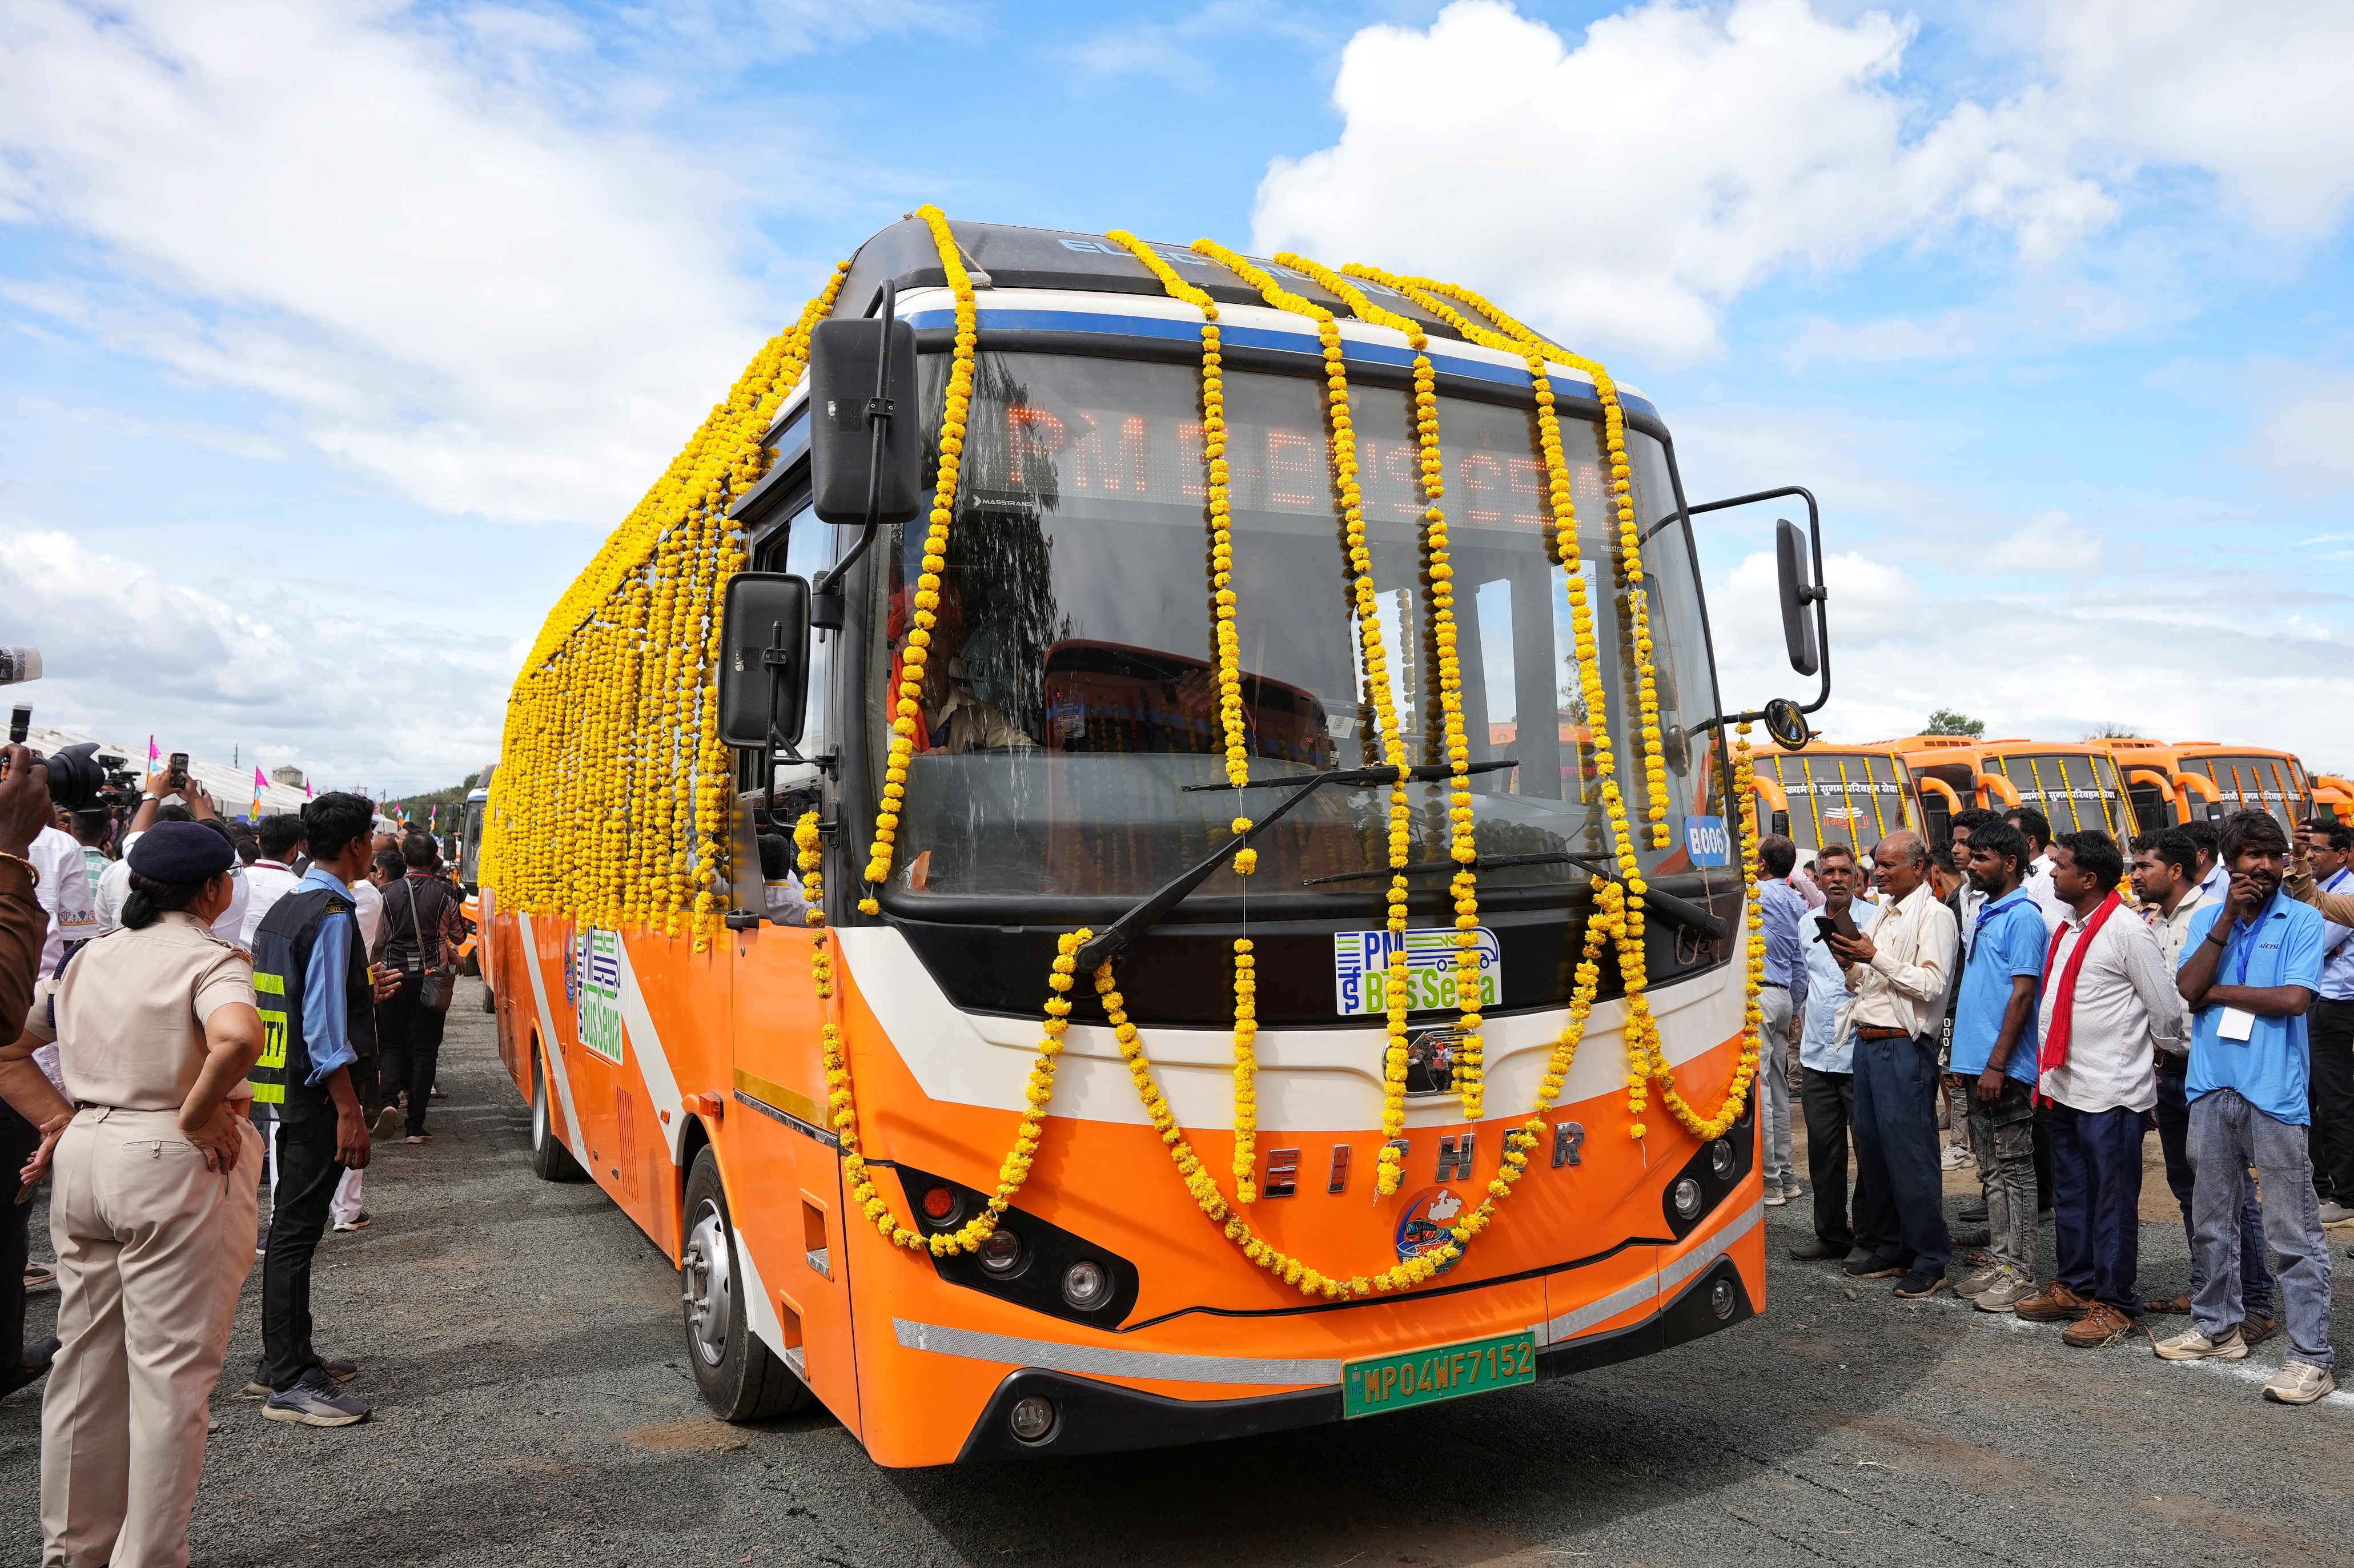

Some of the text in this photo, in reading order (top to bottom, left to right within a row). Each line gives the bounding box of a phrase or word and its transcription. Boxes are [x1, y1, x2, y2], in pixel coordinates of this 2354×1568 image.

[982, 498, 1033, 507] MASSTRANS
[1600, 544, 1626, 553] masstra
[1881, 782, 1898, 794] सेवा
[1689, 827, 1724, 855] B006
[1364, 931, 1404, 970] PM
[1364, 1341, 1532, 1404] MP04WF7152
[1349, 1384, 1364, 1396] IND
